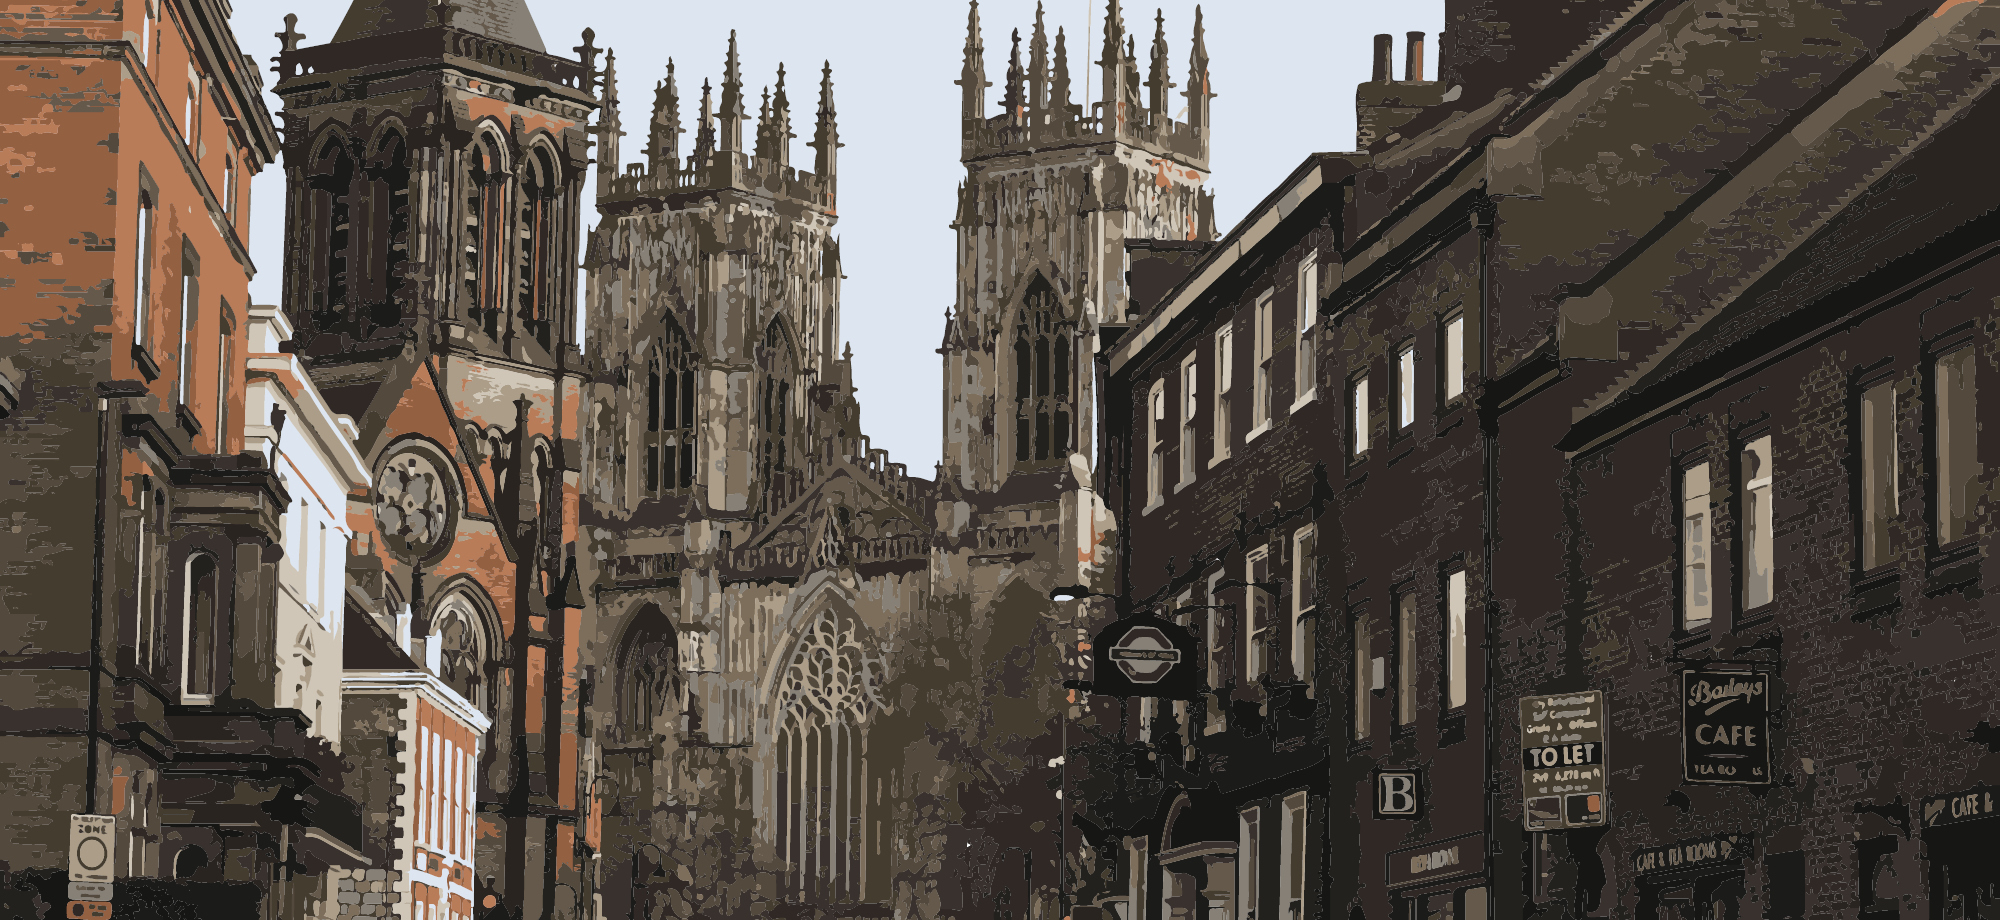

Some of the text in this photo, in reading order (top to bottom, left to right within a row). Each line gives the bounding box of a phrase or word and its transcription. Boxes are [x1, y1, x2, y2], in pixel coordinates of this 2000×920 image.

[1688, 678, 1763, 706] Baileys
[1695, 723, 1757, 747] CAFE
[1529, 743, 1595, 767] TO LET
[1382, 776, 1414, 812] B
[1951, 793, 1979, 819] CAFE
[77, 824, 108, 835] ZONE
